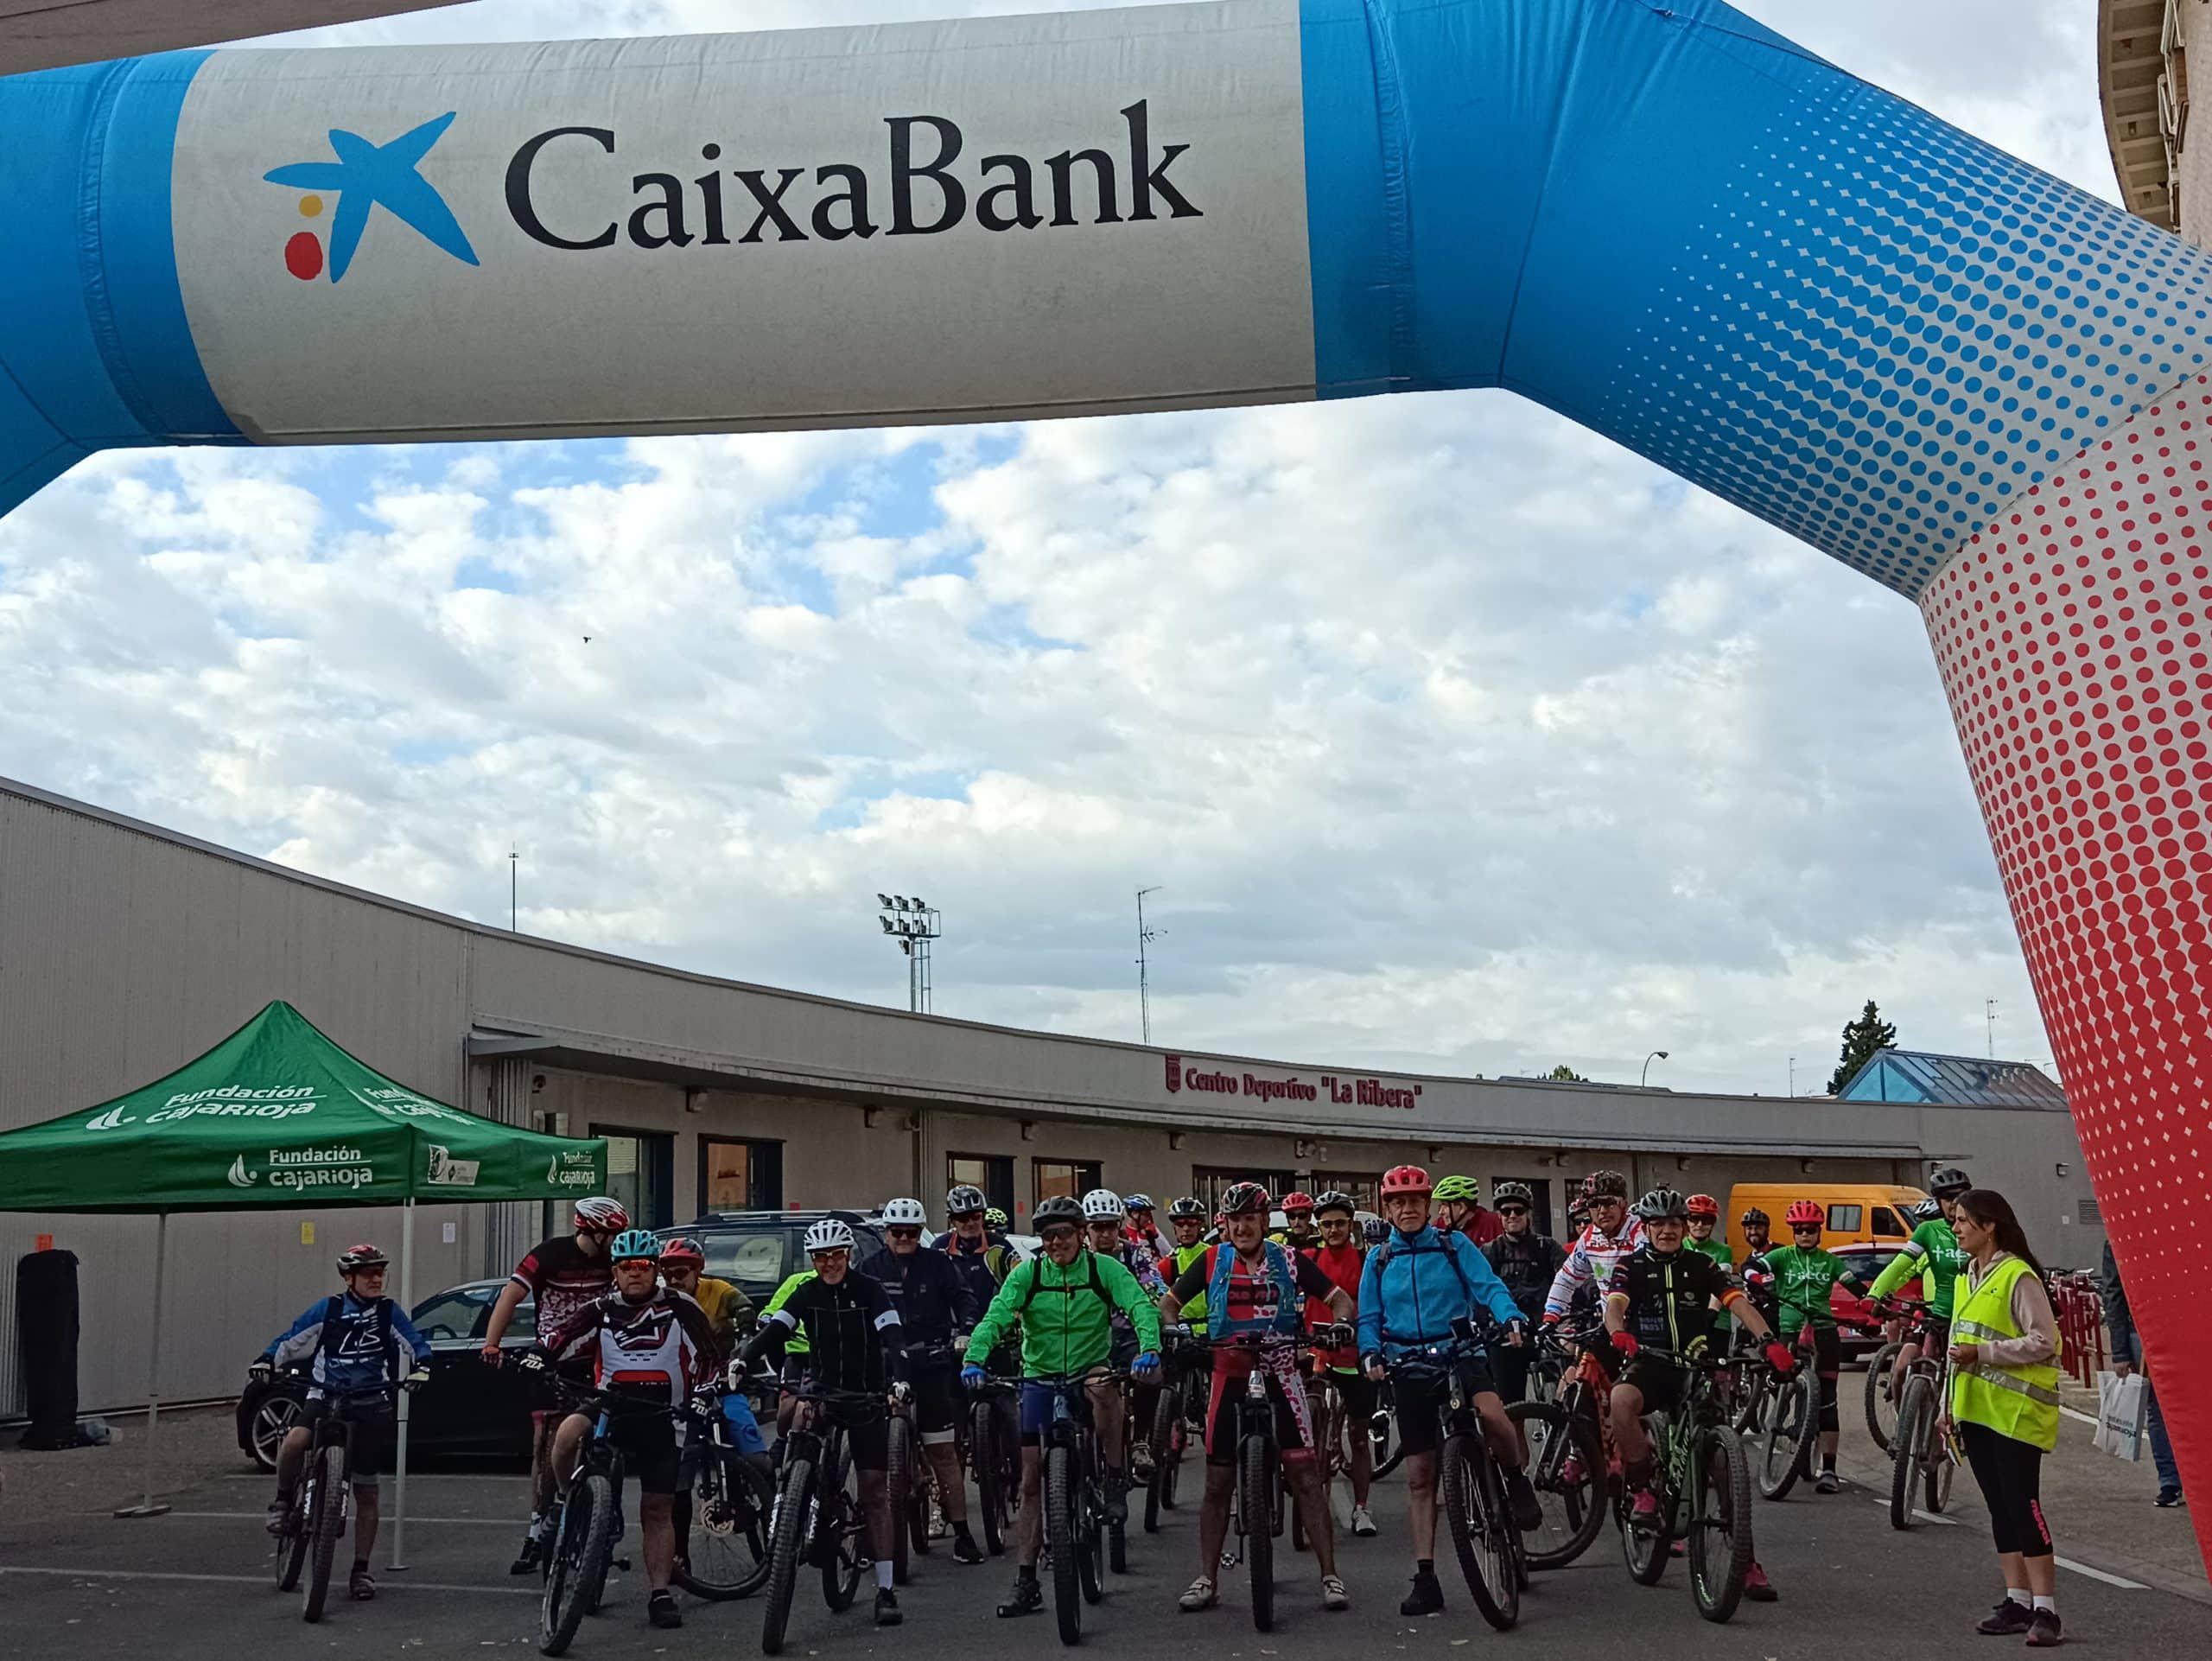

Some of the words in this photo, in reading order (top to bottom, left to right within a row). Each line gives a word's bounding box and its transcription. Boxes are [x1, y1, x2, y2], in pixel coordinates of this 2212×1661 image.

[505, 98, 1204, 250] CaixaBank
[164, 1085, 315, 1107] Fundación
[1185, 1066, 1238, 1094] Centro
[1243, 1072, 1317, 1103] Deportivo
[1321, 1076, 1353, 1104] "La
[1356, 1079, 1422, 1110] Ribera"
[269, 1145, 361, 1163] Fundación
